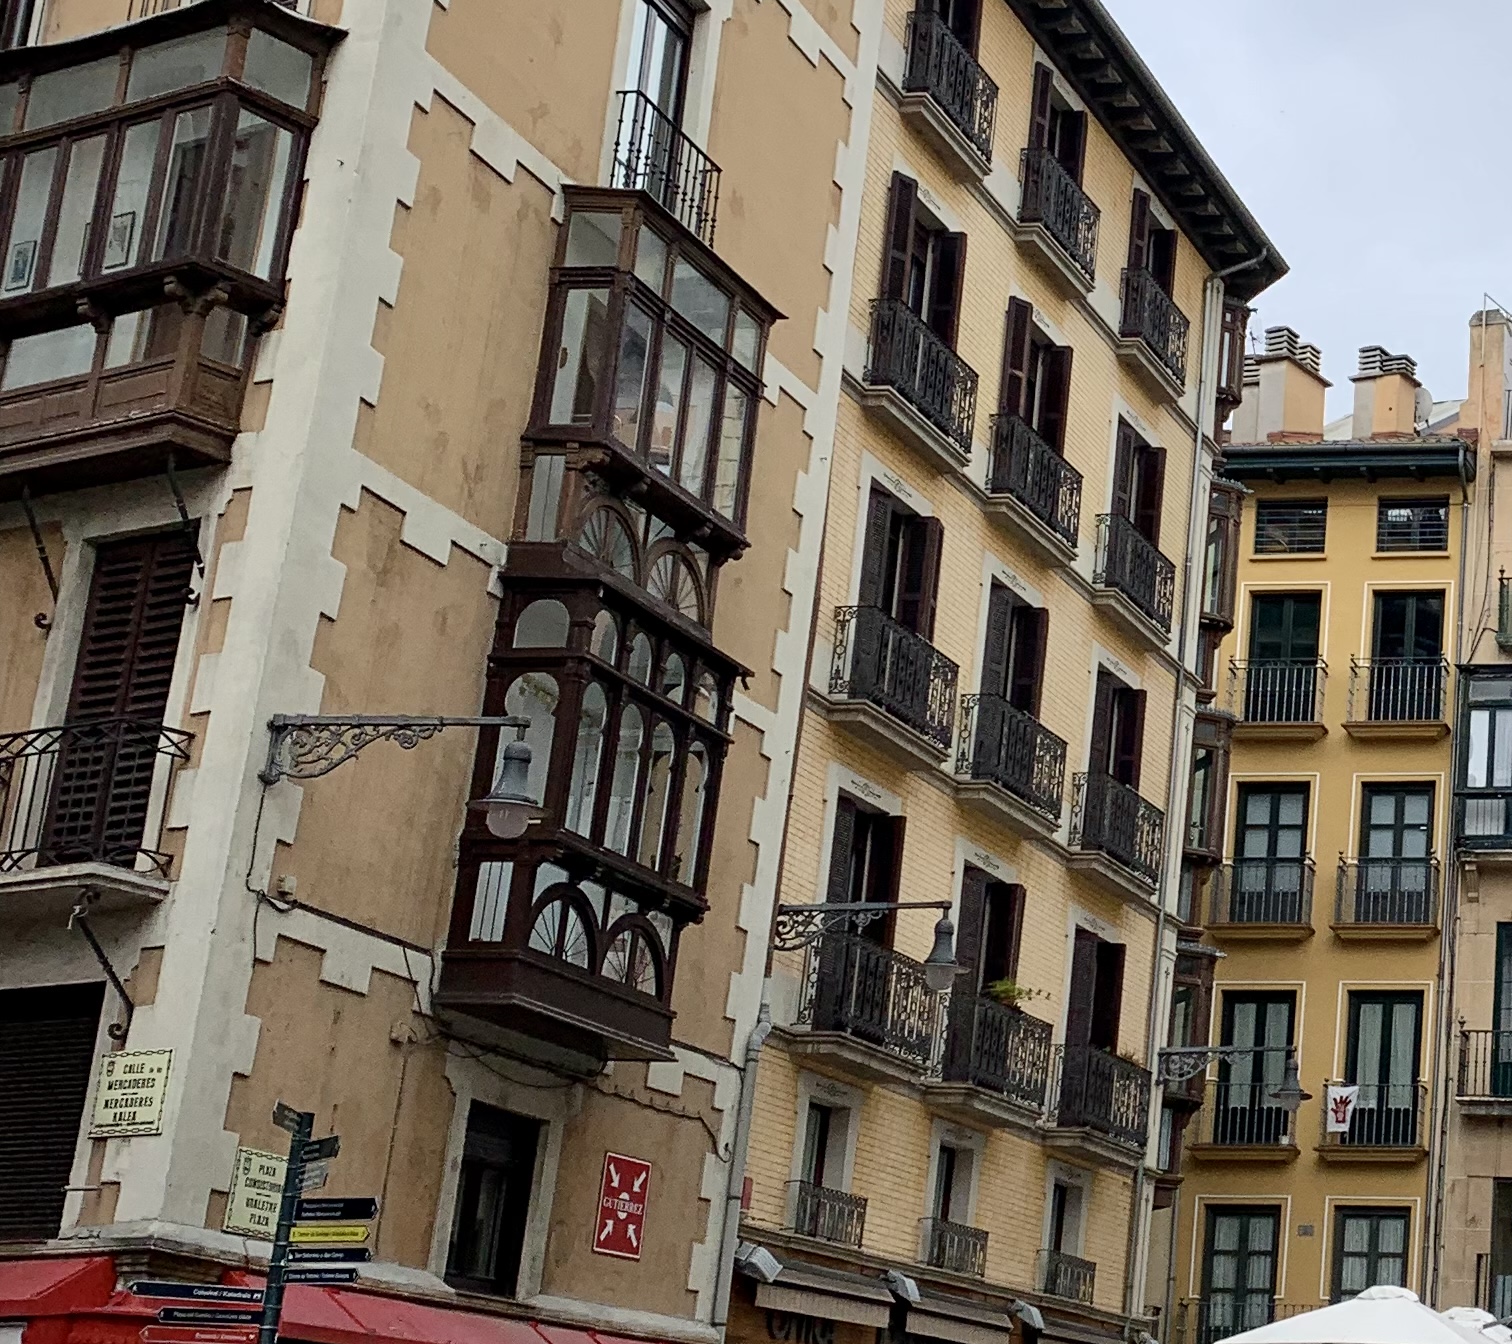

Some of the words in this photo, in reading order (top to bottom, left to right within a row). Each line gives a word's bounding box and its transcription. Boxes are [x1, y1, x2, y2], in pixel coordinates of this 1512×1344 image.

[123, 1063, 145, 1074] CALLE
[107, 1077, 156, 1090] MERCADERES
[103, 1096, 153, 1109] MERCADERES
[258, 1164, 276, 1177] PLAZA
[603, 1196, 643, 1215] GUTIERREZ
[249, 1213, 269, 1227] PLAZA
